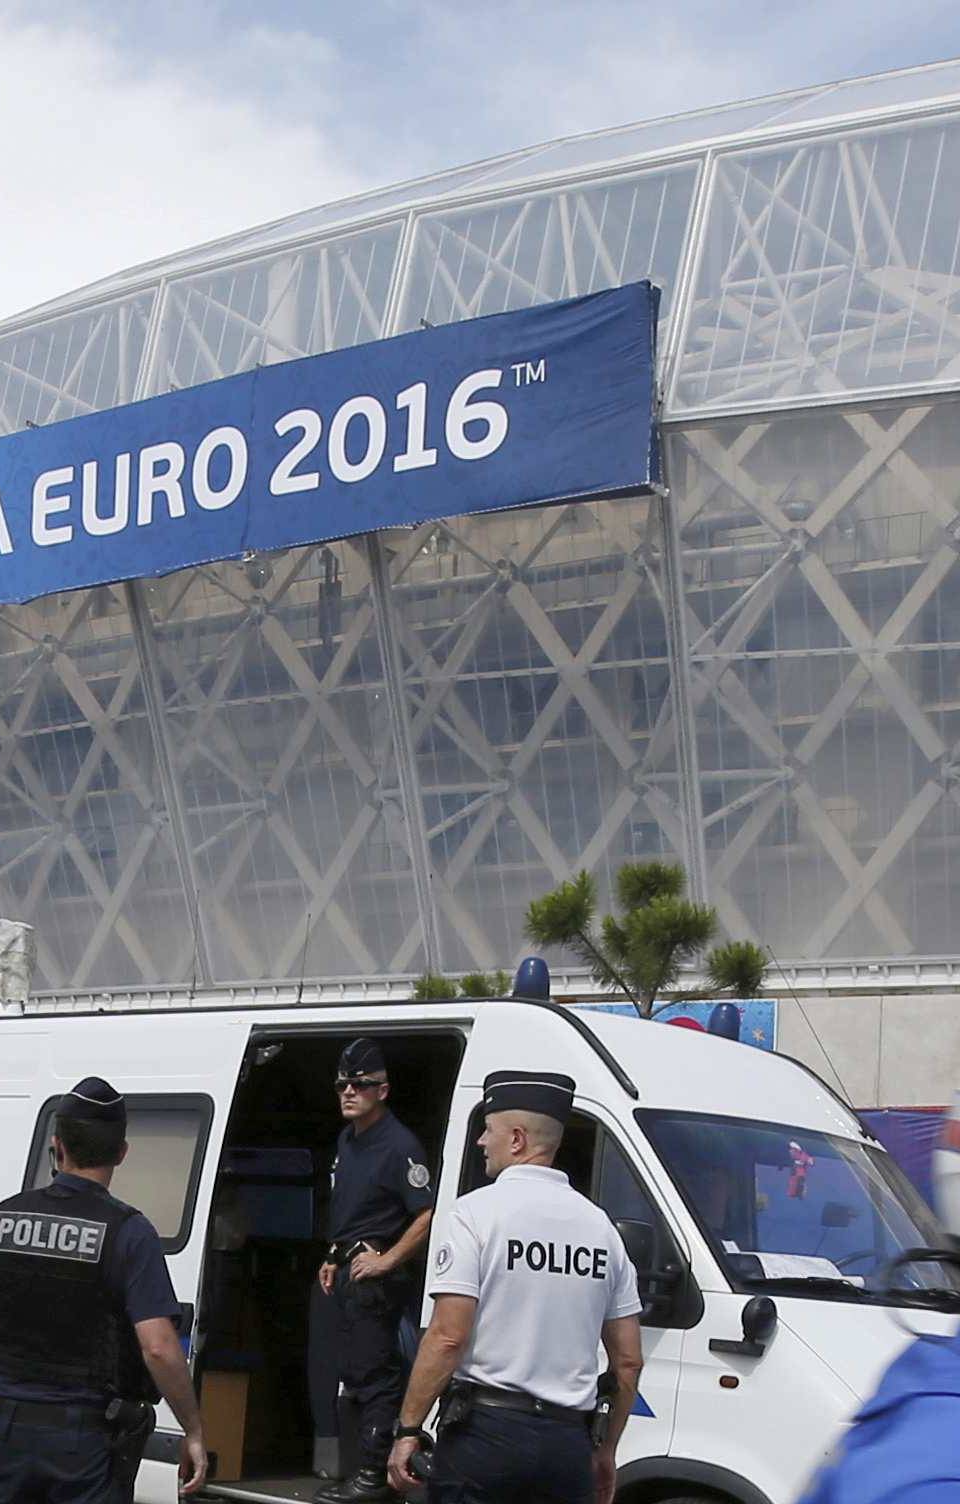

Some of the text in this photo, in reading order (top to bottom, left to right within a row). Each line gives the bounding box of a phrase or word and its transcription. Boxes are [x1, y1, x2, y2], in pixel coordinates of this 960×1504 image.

[31, 426, 248, 547] EURO
[269, 368, 510, 497] 2016
[510, 359, 546, 388] TM
[506, 1239, 608, 1280] POLICE
